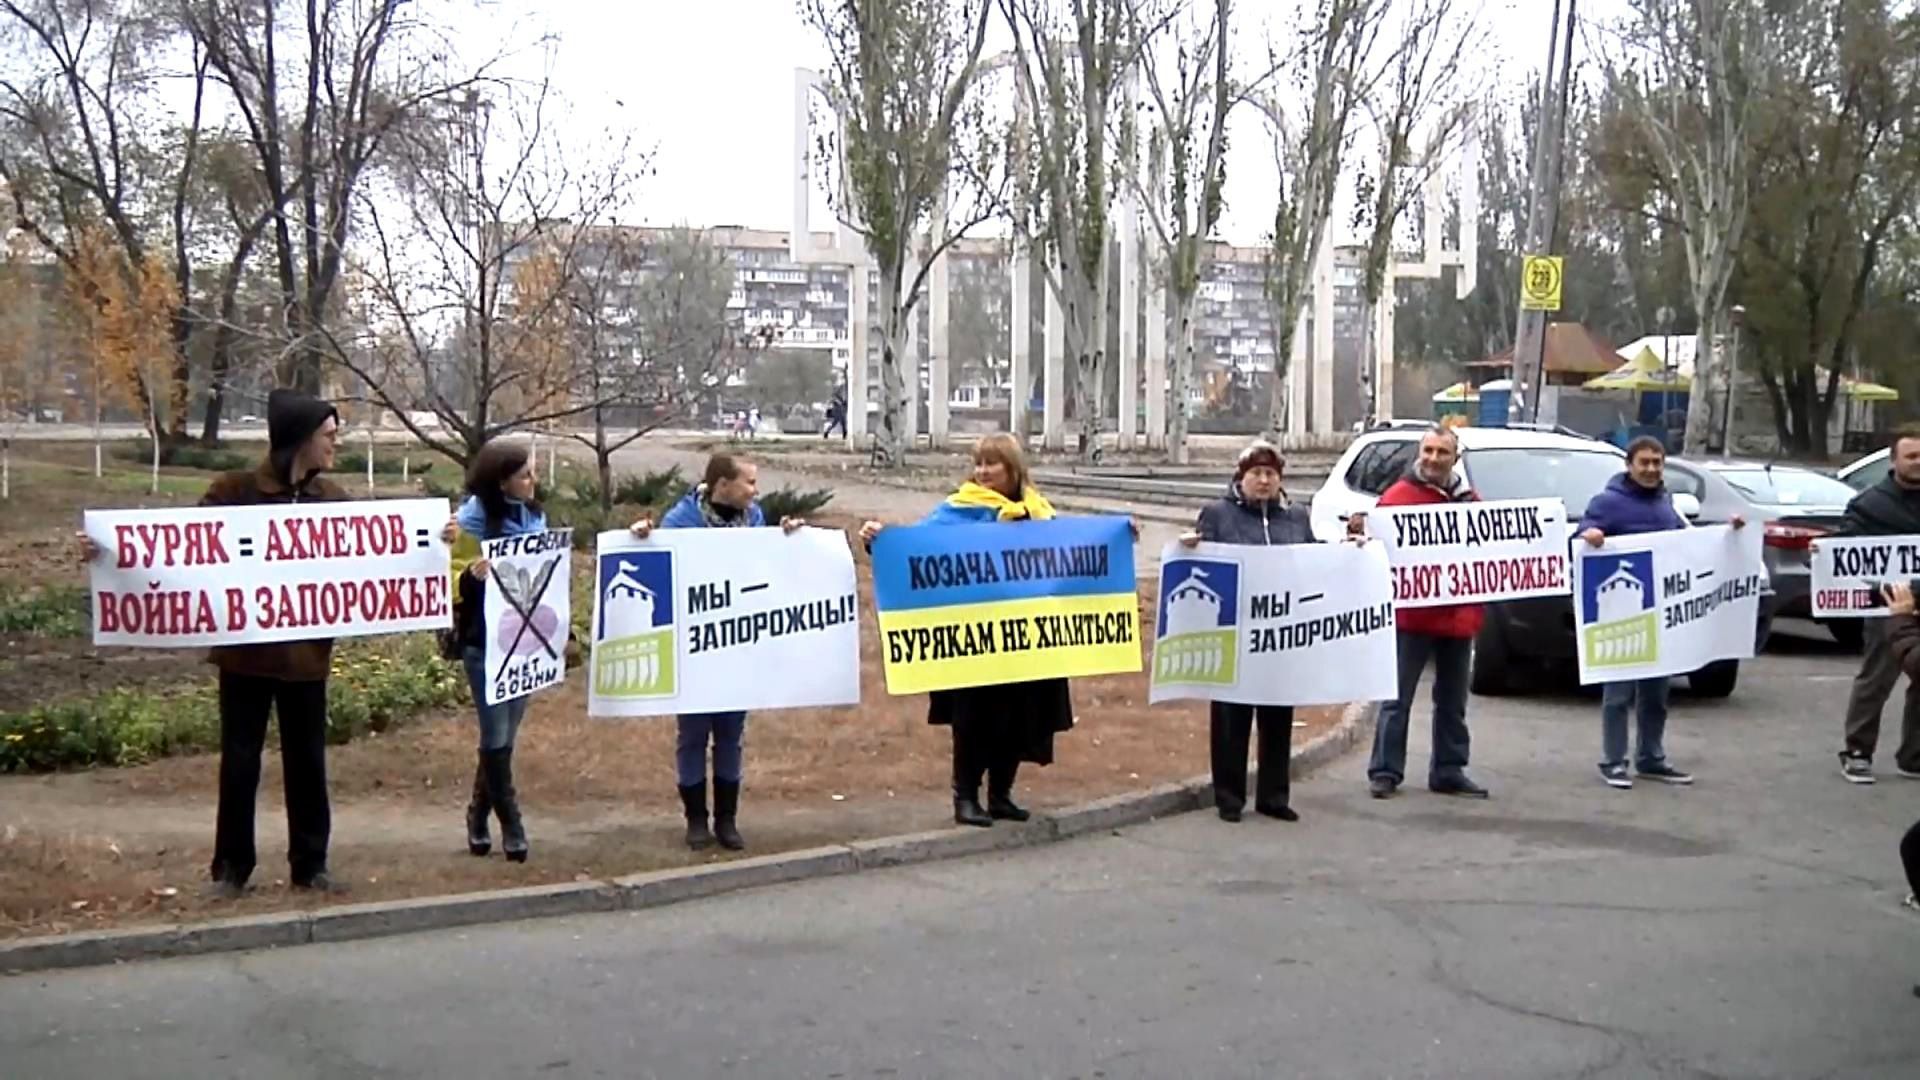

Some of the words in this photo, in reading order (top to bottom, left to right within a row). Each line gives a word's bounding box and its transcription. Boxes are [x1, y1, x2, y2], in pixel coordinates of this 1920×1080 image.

[115, 520, 229, 568] БУРЯК
[239, 537, 254, 556] =
[265, 514, 407, 561] АХМЕТОВ
[417, 529, 429, 547] =
[488, 536, 523, 559] НЕТ
[1393, 511, 1460, 547] УБИЛИ
[908, 550, 999, 590] КОЗАЧА
[1001, 544, 1108, 580] ПОТИЛИЦЯ
[1448, 555, 1564, 598] ЗАПОРОЖЬЕ!
[1832, 545, 1892, 577] КОМУ
[688, 580, 730, 614] МЫ
[1663, 569, 1690, 598] МЫ
[98, 581, 217, 634] ВОЙНА
[226, 588, 247, 631] В
[256, 575, 448, 629] ЗАПОРОЖЬЕ!
[689, 594, 855, 654] ЗАПОРОЖЦЫ!
[1251, 591, 1290, 619] МЫ
[887, 620, 996, 663] БУРЯКАМ
[1000, 617, 1030, 651] НЕ
[1034, 611, 1132, 648] ХИЛИТЬСЯ!
[1249, 602, 1393, 653] ЗАПОРОЖЦЫ!
[508, 657, 540, 681] НЕТ
